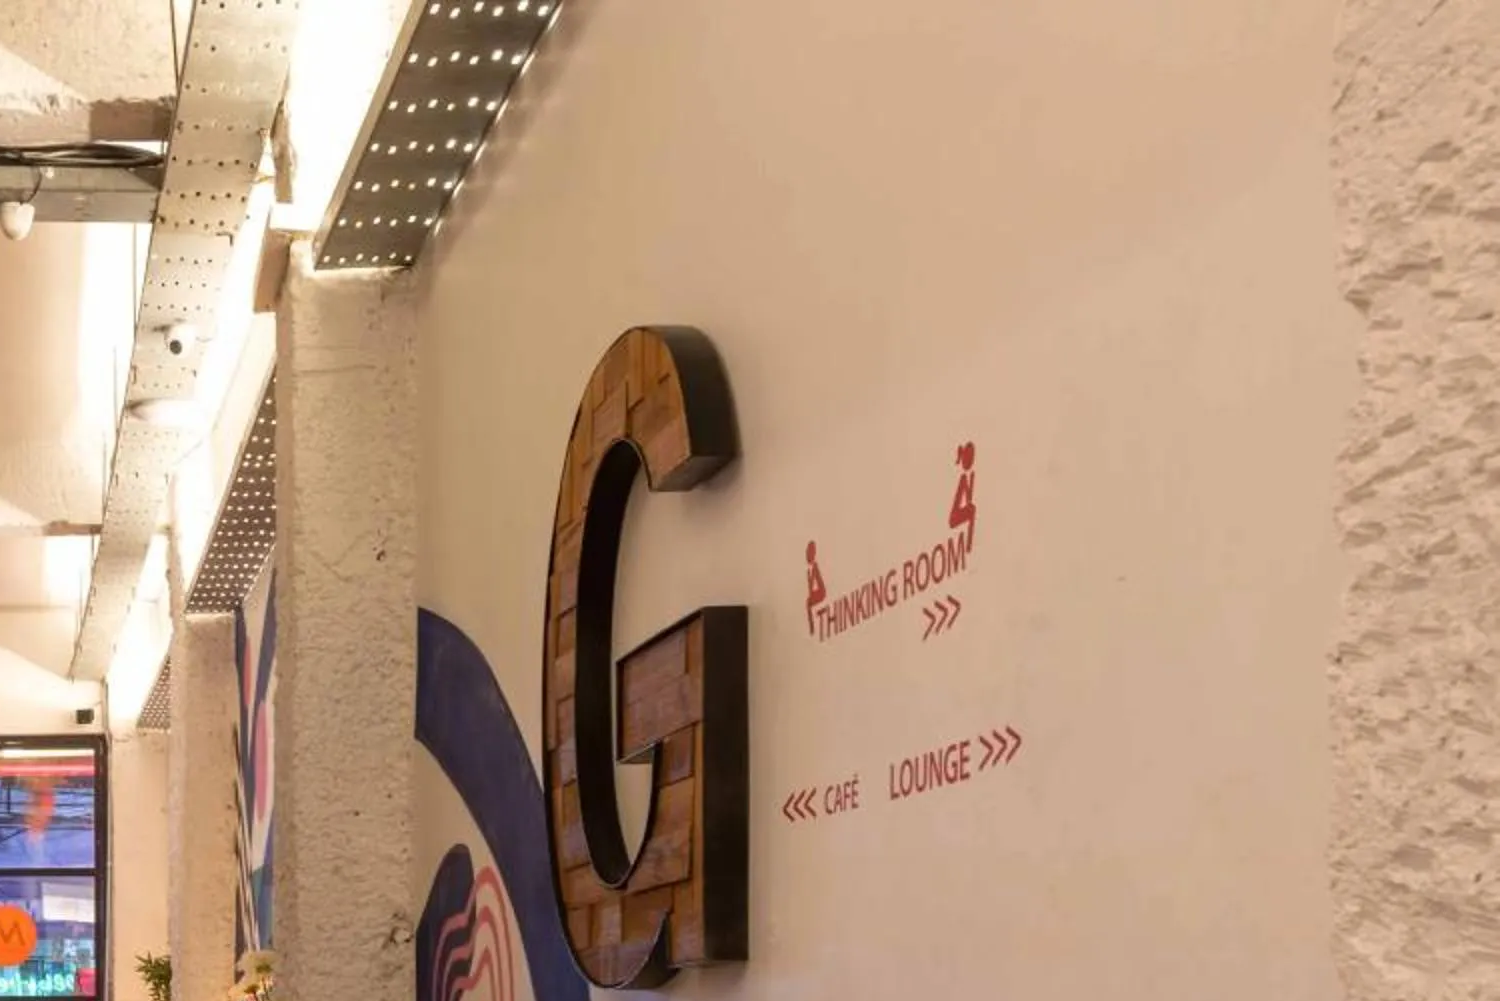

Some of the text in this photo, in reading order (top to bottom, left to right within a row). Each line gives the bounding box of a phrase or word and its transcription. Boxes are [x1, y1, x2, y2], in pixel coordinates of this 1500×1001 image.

[816, 531, 966, 642] THINKING ROOM
[543, 326, 748, 988] G
[823, 773, 860, 815] CAFÉ
[888, 740, 971, 801] LOUNGE
